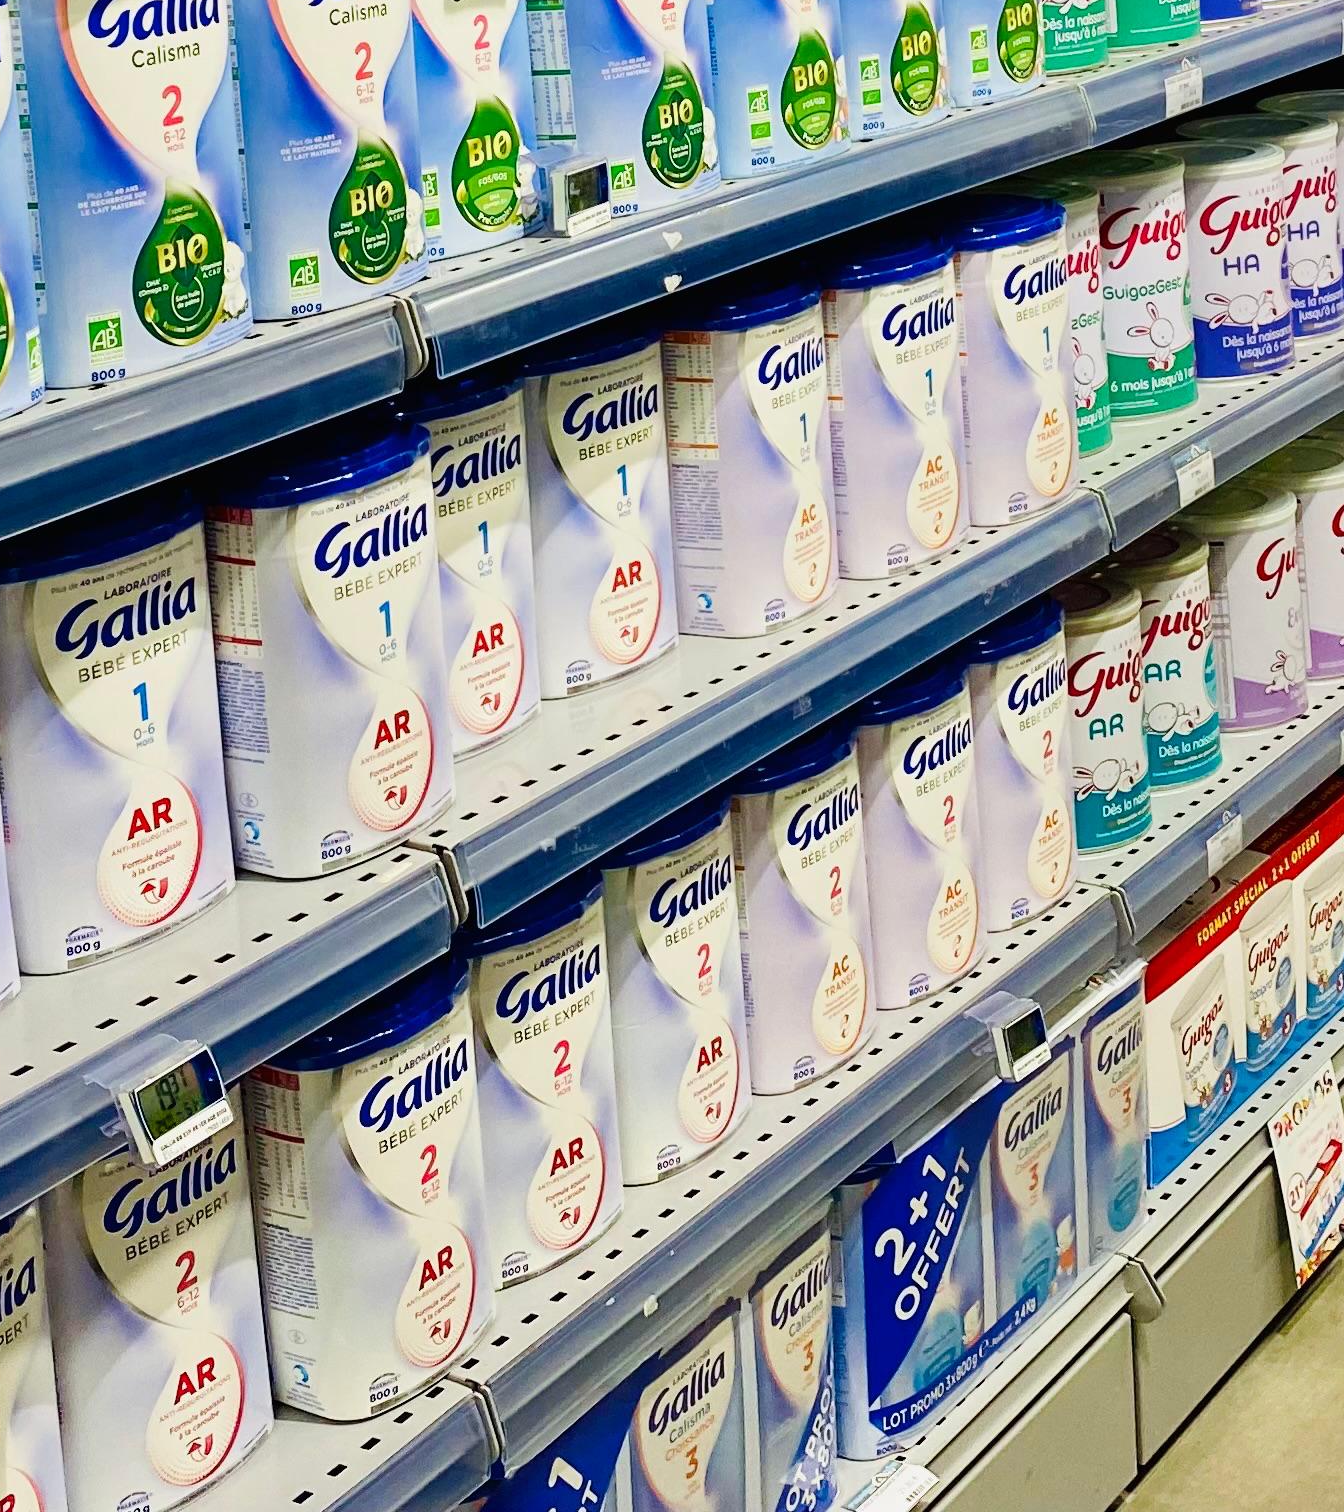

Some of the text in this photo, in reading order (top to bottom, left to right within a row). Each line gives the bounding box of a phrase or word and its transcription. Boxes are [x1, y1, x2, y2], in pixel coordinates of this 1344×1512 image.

[793, 63, 828, 93] BIO
[162, 85, 184, 127] 2
[157, 235, 208, 273] BIO
[1223, 254, 1260, 277] HA
[1103, 277, 1182, 301] GuigozGest
[91, 320, 121, 350] AB
[882, 295, 955, 347] Gallia
[91, 368, 125, 382] 800 g
[919, 473, 949, 492] TRANSIT
[313, 504, 428, 578] Gallia
[1197, 904, 1232, 948] FORMAT
[1233, 876, 1269, 914] SPÉCIAL
[1291, 831, 1321, 869] OFFERT
[359, 1038, 469, 1132] Gallia
[419, 1145, 439, 1185] 2
[895, 1147, 970, 1321] OFFERT
[883, 1408, 907, 1431] LOT
[910, 1381, 945, 1417] PROMO
